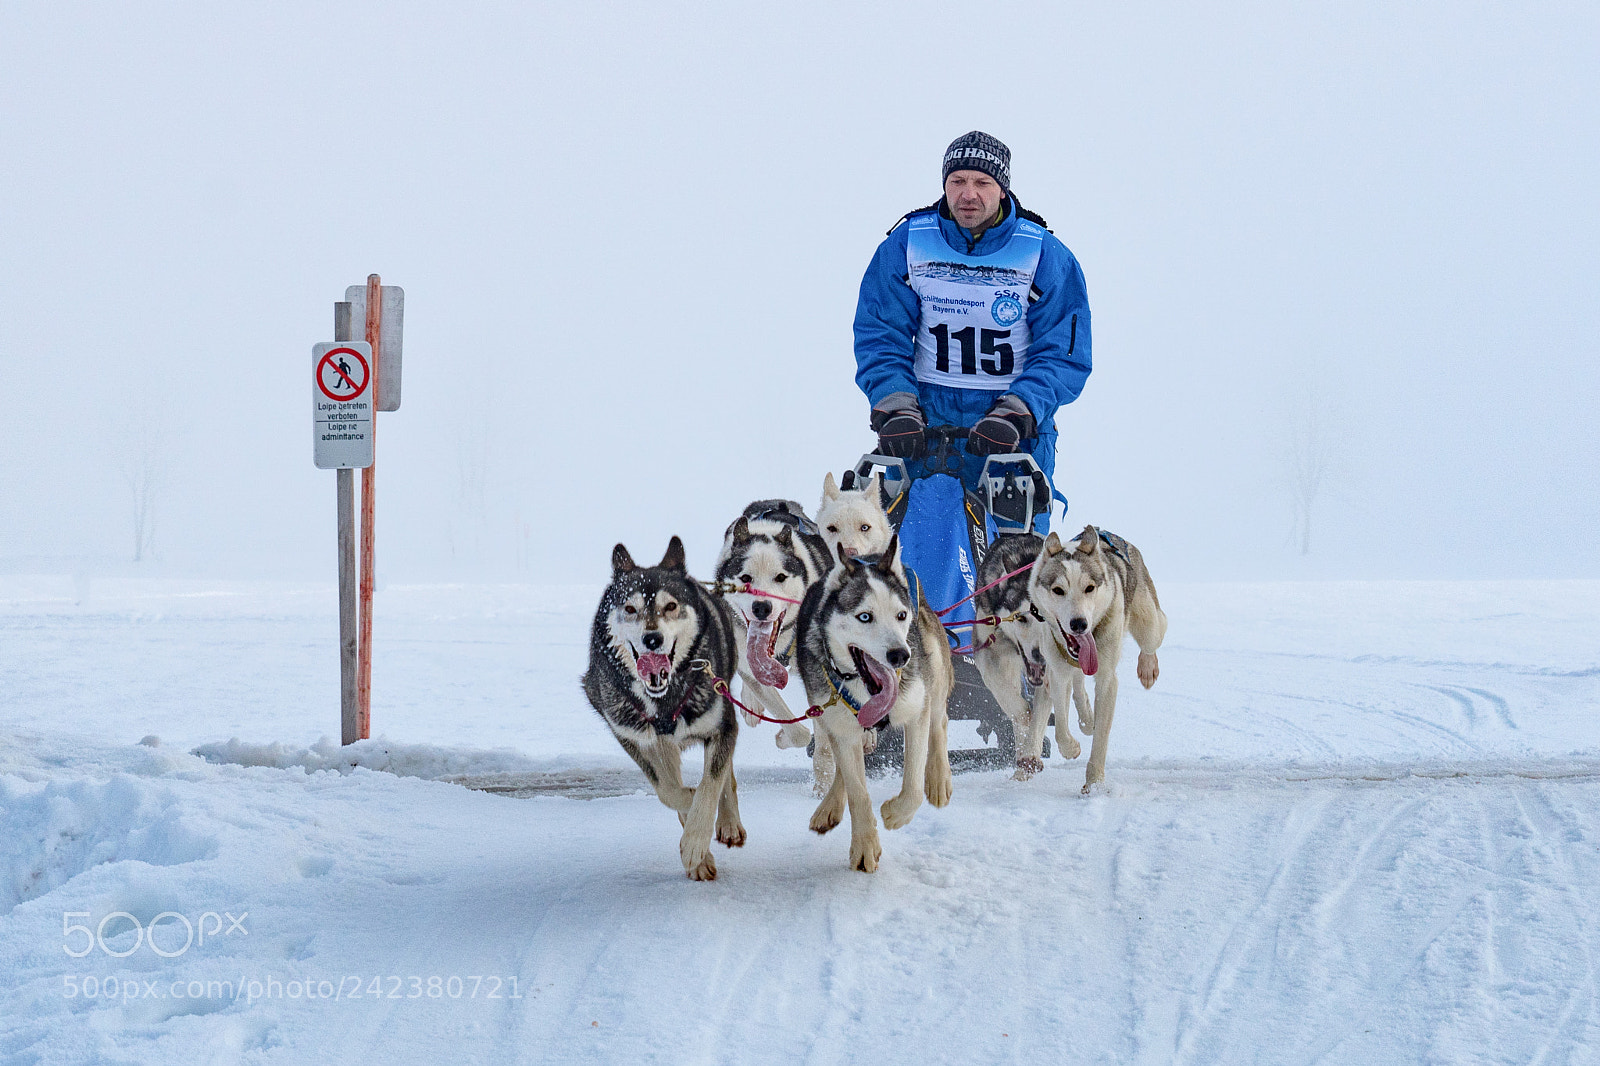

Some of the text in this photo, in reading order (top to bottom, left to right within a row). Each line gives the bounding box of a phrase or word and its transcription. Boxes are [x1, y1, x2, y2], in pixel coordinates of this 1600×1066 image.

[963, 147, 1005, 169] HAPPY
[994, 289, 1021, 301] SSB
[932, 304, 969, 315] Bayern e.V.
[928, 323, 1015, 376] 115
[318, 402, 367, 412] Loipe betreten
[327, 412, 358, 420] verboten
[328, 423, 347, 432] Loipe
